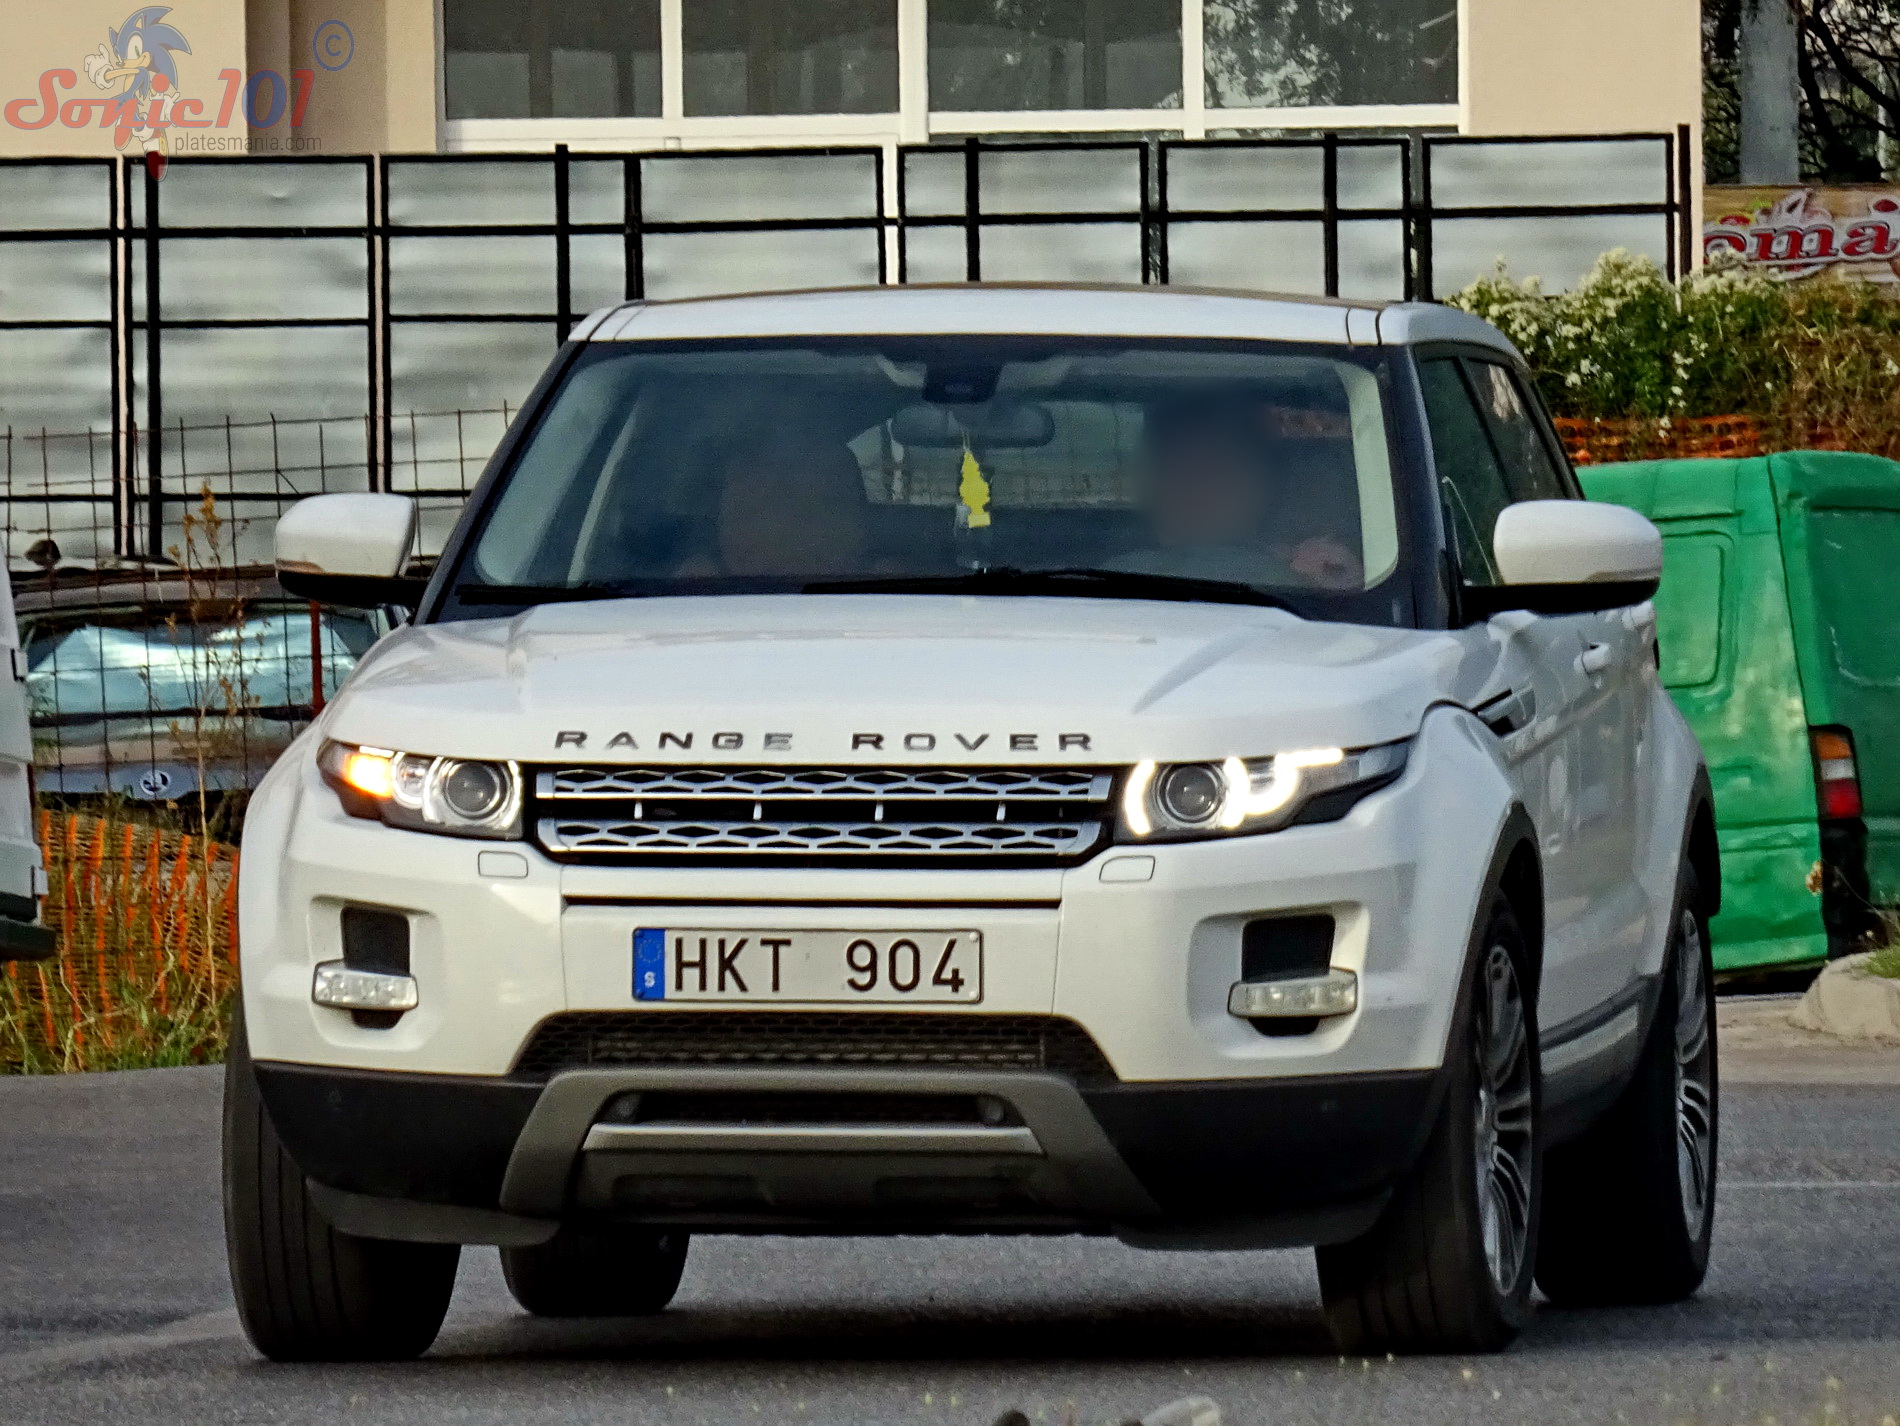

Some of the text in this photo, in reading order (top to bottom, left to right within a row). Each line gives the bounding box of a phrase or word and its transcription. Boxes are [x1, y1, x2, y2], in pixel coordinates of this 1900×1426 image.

[555, 731, 1092, 752] RANGE ROVER
[674, 936, 965, 993] HKT 904
